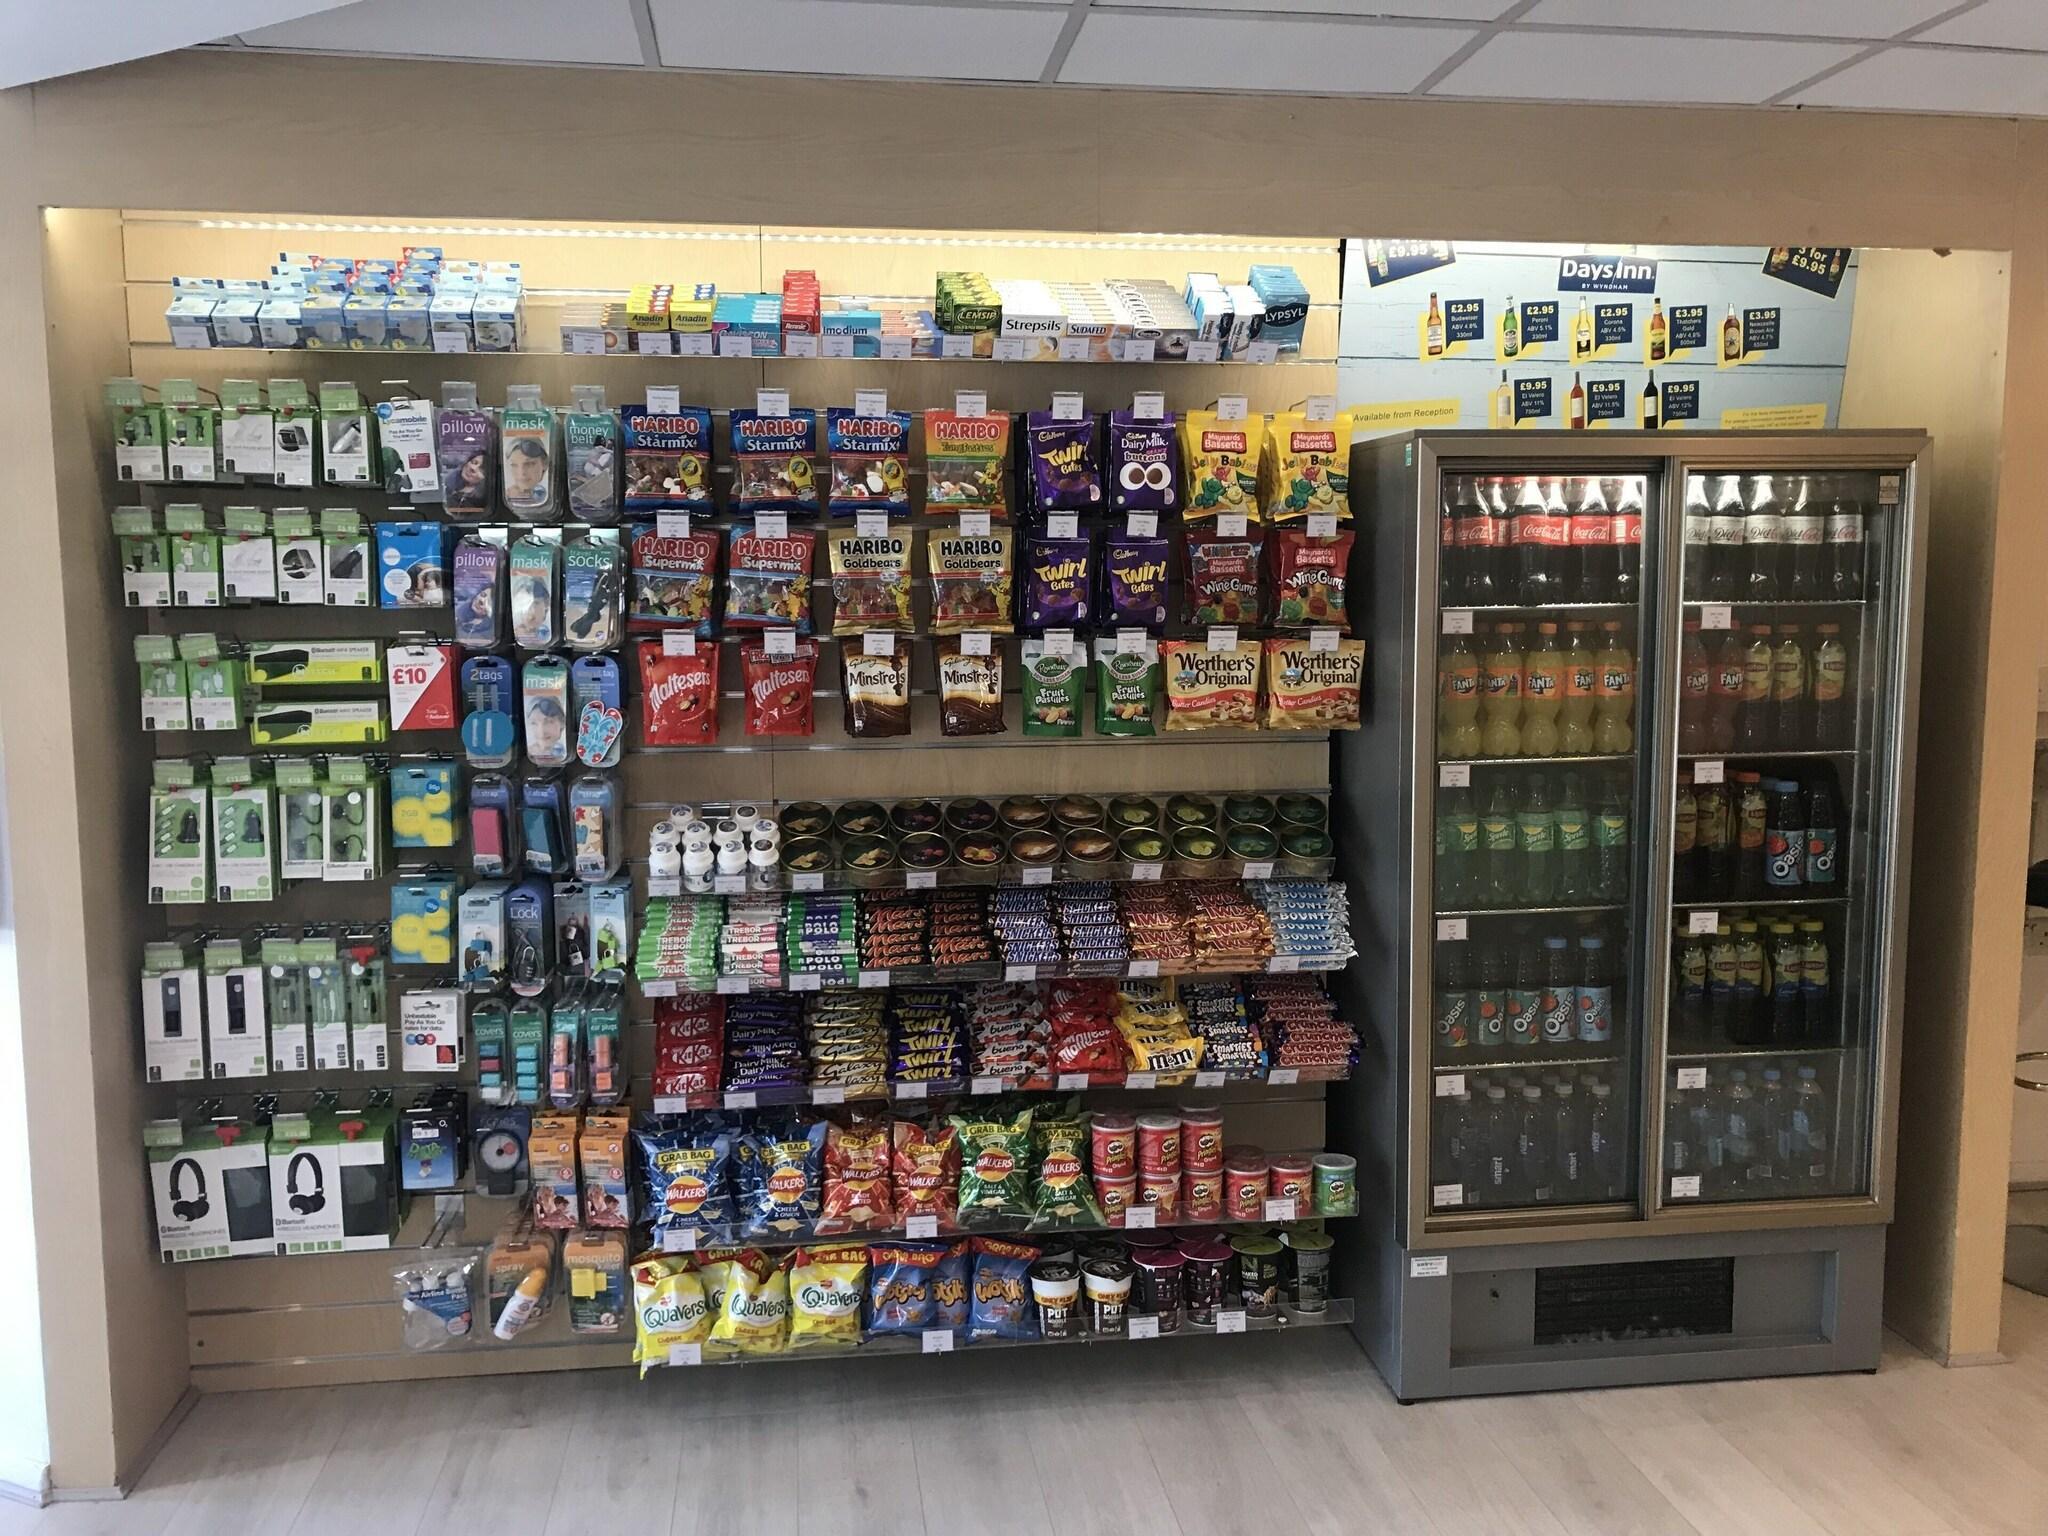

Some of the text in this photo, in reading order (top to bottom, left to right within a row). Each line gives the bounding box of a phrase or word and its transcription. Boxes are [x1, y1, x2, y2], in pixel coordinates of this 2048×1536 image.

[1562, 259, 1613, 284] Days
[1791, 257, 1826, 282] £9.95
[1265, 307, 1305, 323] LYPSYL
[1451, 303, 1479, 313] £2.95
[1527, 305, 1554, 315] £2.95
[1600, 308, 1628, 318] £2.95
[1676, 308, 1703, 318] £3.95
[632, 313, 663, 325] Anadin
[675, 313, 707, 325] Anadin
[959, 311, 998, 322] LEMSIP
[1749, 311, 1776, 321] £3.95
[823, 325, 868, 338] Imodium
[1006, 319, 1061, 333] Strepsils
[1071, 325, 1106, 336] SUDAFED
[1520, 381, 1547, 391] £9.95
[1592, 383, 1620, 393] £9.95
[1668, 384, 1695, 394] £9.95
[1353, 407, 1454, 422] Available from Reception
[441, 420, 486, 436] pillow
[505, 417, 545, 430] mask
[569, 425, 609, 436] money
[631, 416, 699, 435] HARIBO
[740, 419, 808, 437] HARIBO
[838, 418, 902, 438] HARIBO
[935, 421, 1001, 440] HARIBO
[571, 434, 594, 445] belt
[637, 434, 697, 449] Starmix
[747, 436, 806, 452] Starmix
[1121, 437, 1169, 451] Dairy Milk
[1296, 433, 1329, 441] Maynards
[842, 437, 900, 452] Starmix
[1204, 440, 1243, 450] Bassetts
[1293, 439, 1333, 450] Bassetts
[1124, 450, 1167, 463] buttons
[1282, 455, 1308, 471] Jelly
[639, 536, 710, 560] HARIBO
[737, 537, 807, 560] HARIBO
[840, 539, 903, 555] HARIBO
[941, 539, 1003, 556] HARIBO
[455, 554, 496, 568] pillow
[568, 554, 611, 568] socks
[643, 555, 705, 571] Supermix
[741, 556, 801, 572] Supermix
[843, 558, 901, 569] Goldbears
[944, 558, 1001, 570] Goldbears
[1296, 555, 1334, 565] Bassetts
[1034, 557, 1087, 583] Twirl
[1112, 560, 1166, 585] Twirl
[1286, 570, 1317, 589] Wine
[1131, 582, 1154, 594] Bites
[1229, 578, 1258, 596] Gums
[1175, 652, 1255, 673] Werther's
[1280, 651, 1360, 670] Werther's
[392, 667, 427, 685] £10
[849, 671, 905, 688] Minstrels
[944, 670, 998, 686] Minstrels
[1196, 669, 1252, 688] Original
[1301, 667, 1357, 687] Original
[1526, 675, 1555, 689] FANTA
[1720, 672, 1744, 686] FANT
[649, 671, 711, 711] Maltesers
[1111, 691, 1146, 702] Pastilles
[1116, 684, 1140, 695] Fruit
[511, 907, 539, 919] Lock
[1280, 911, 1333, 921] BOUNTY
[729, 925, 761, 934] TREBOR
[1205, 921, 1259, 938] TWIX
[805, 956, 840, 964] POLO
[1007, 951, 1061, 963] SNICKERS
[1545, 992, 1574, 1034] Oasis
[513, 1030, 542, 1038] covers
[1290, 1031, 1351, 1042] Crunchie
[991, 1042, 1024, 1054] bueno
[989, 1063, 1023, 1075] bueno
[969, 1125, 995, 1135] GRAB
[690, 1149, 712, 1160] BAG
[976, 1158, 1013, 1169] WALKERS
[1042, 1162, 1081, 1174] WALKERS
[666, 1188, 707, 1199] WALKERS
[495, 1263, 525, 1274] spray
[567, 1254, 621, 1269] mosquito
[802, 1286, 861, 1309] Quavers
[731, 1293, 785, 1317] Quavers
[643, 1298, 706, 1329] Quavers
[1047, 1307, 1068, 1319] POT
